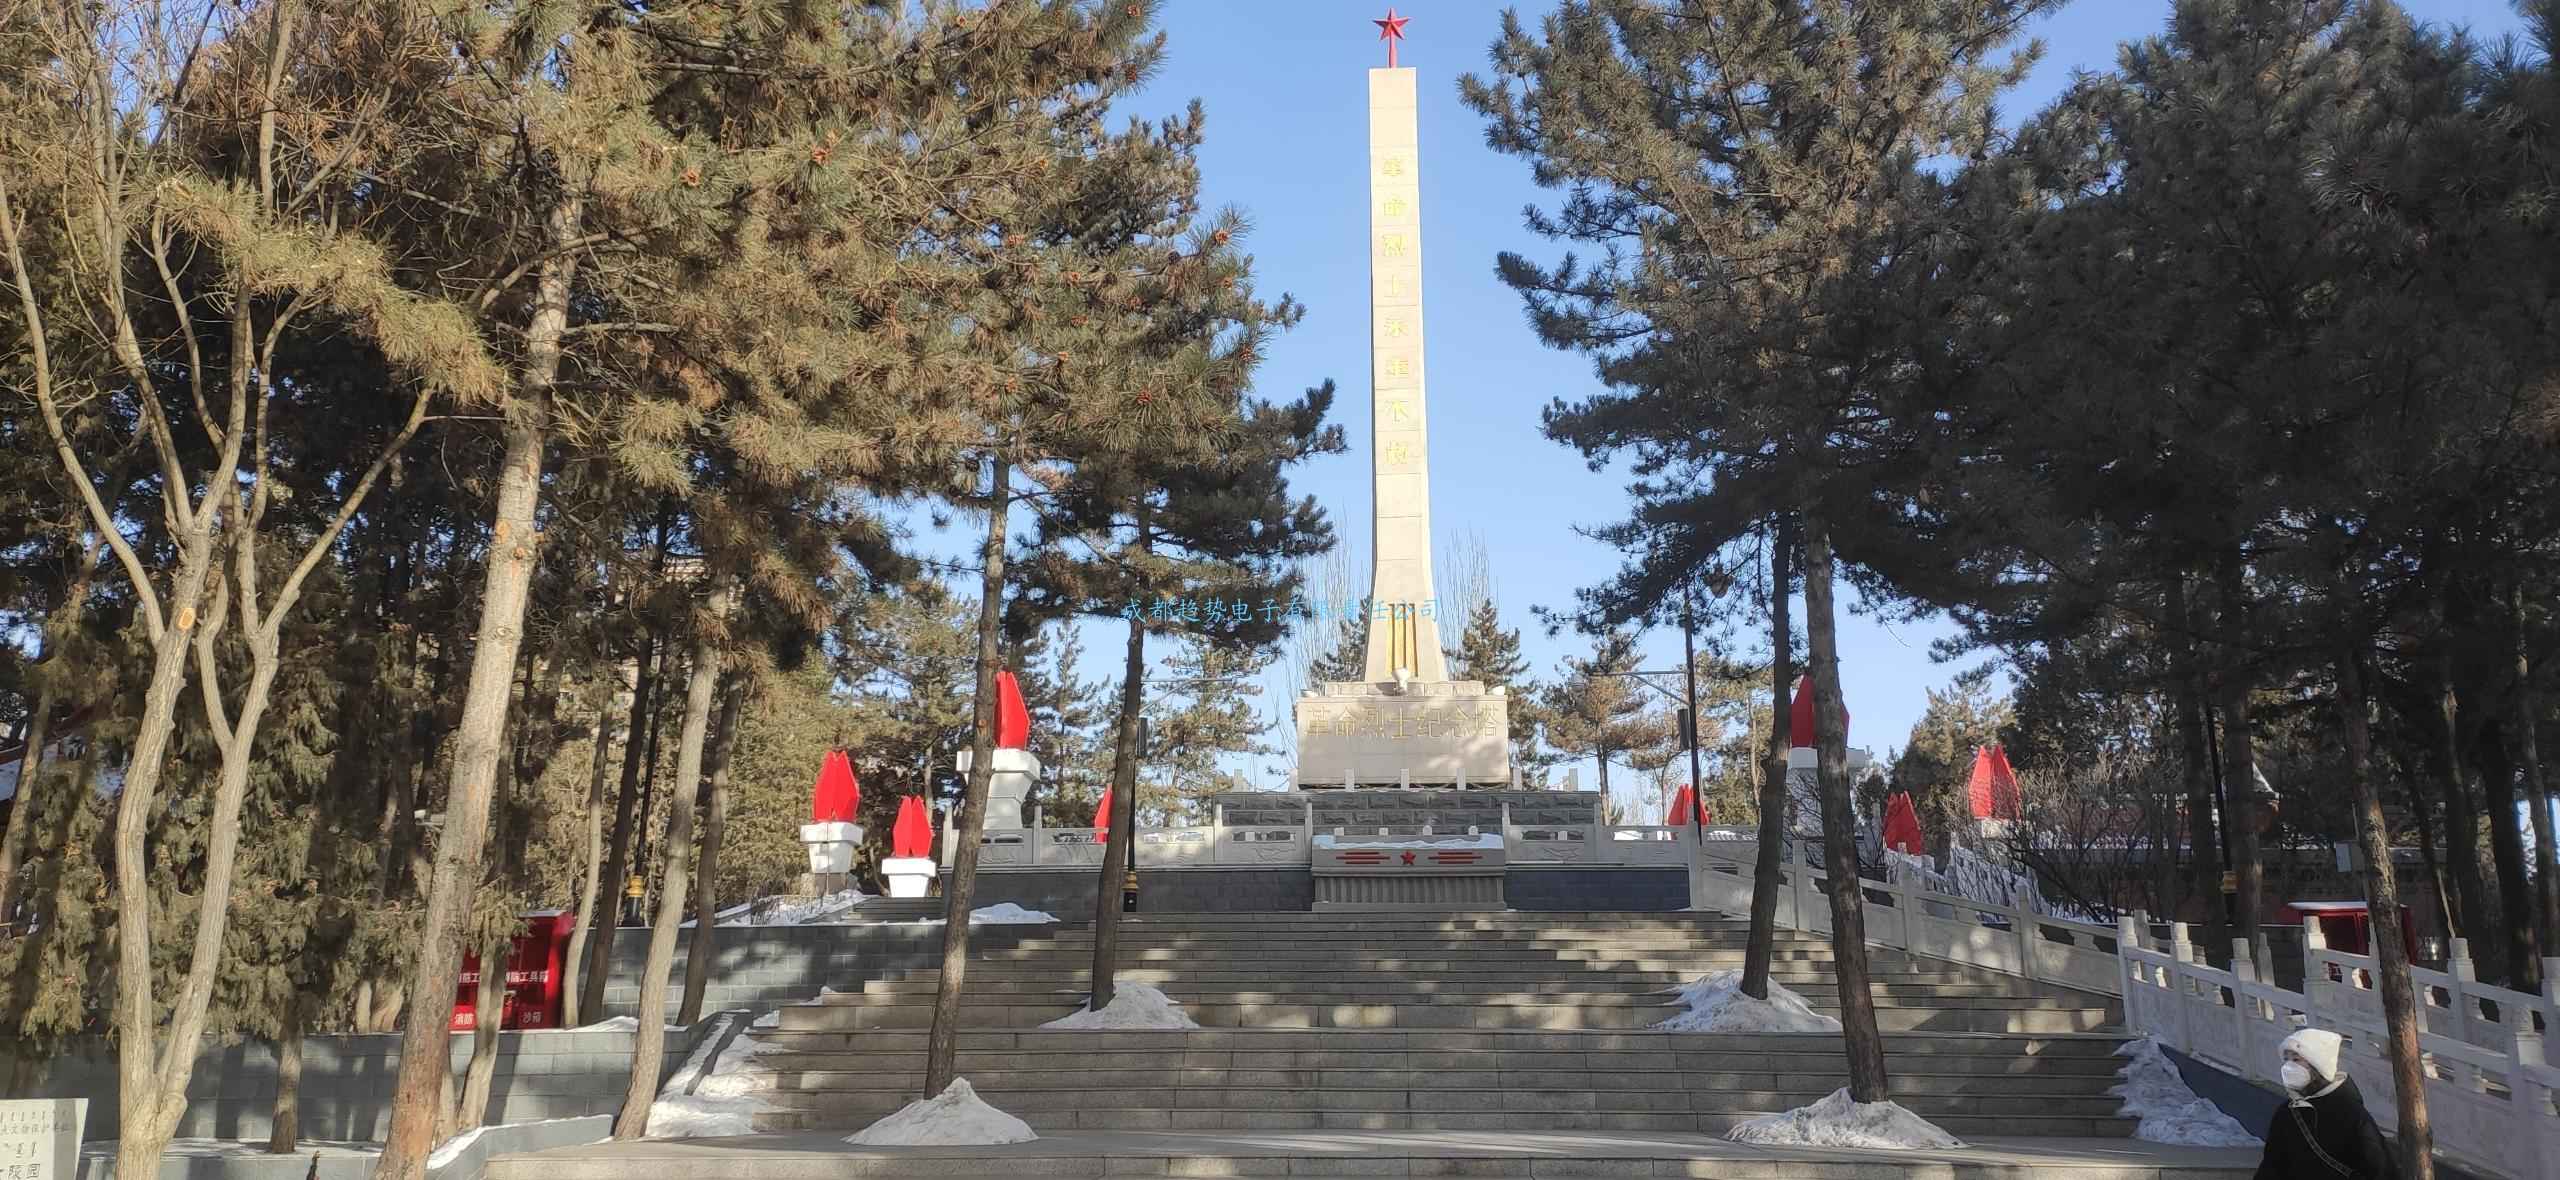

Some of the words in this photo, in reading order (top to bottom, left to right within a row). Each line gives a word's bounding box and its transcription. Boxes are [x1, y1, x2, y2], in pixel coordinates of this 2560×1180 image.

[1305, 703, 1500, 740] 革命烈士纪念塔
